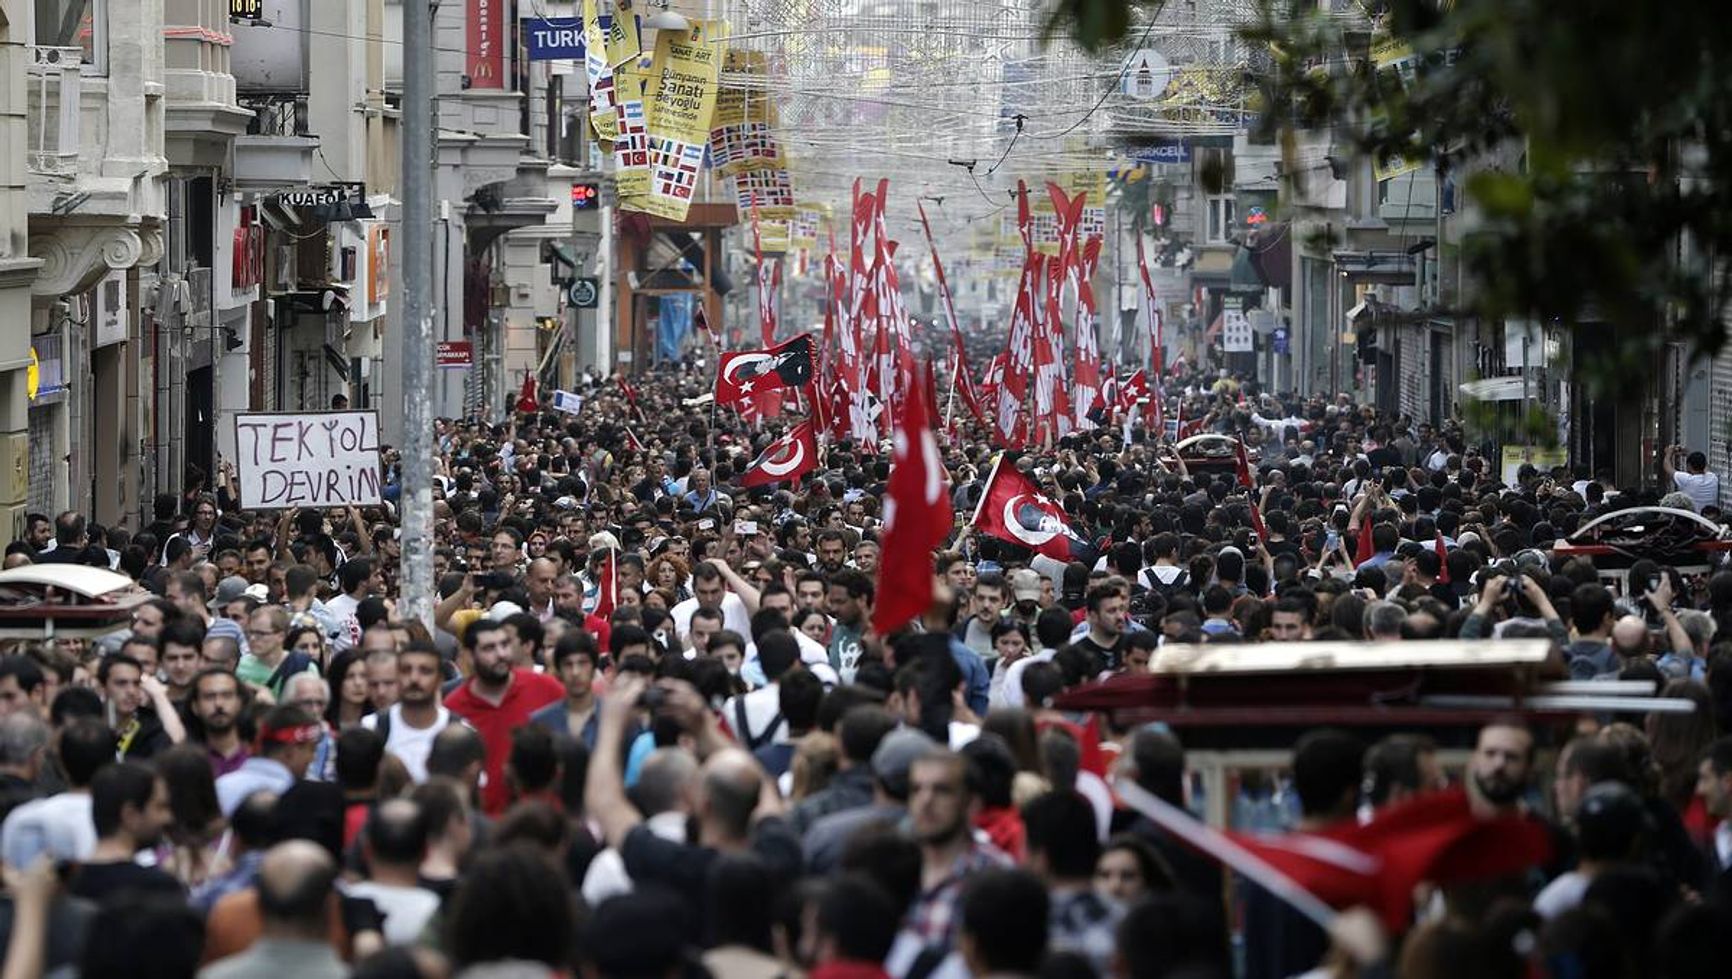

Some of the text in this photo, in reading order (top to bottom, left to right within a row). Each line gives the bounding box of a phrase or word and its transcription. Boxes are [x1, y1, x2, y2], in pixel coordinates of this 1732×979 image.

[695, 49, 713, 61] ART
[659, 77, 704, 98] Sanatı
[655, 92, 701, 111] Beyoğlu
[239, 416, 380, 466] TEK YOL
